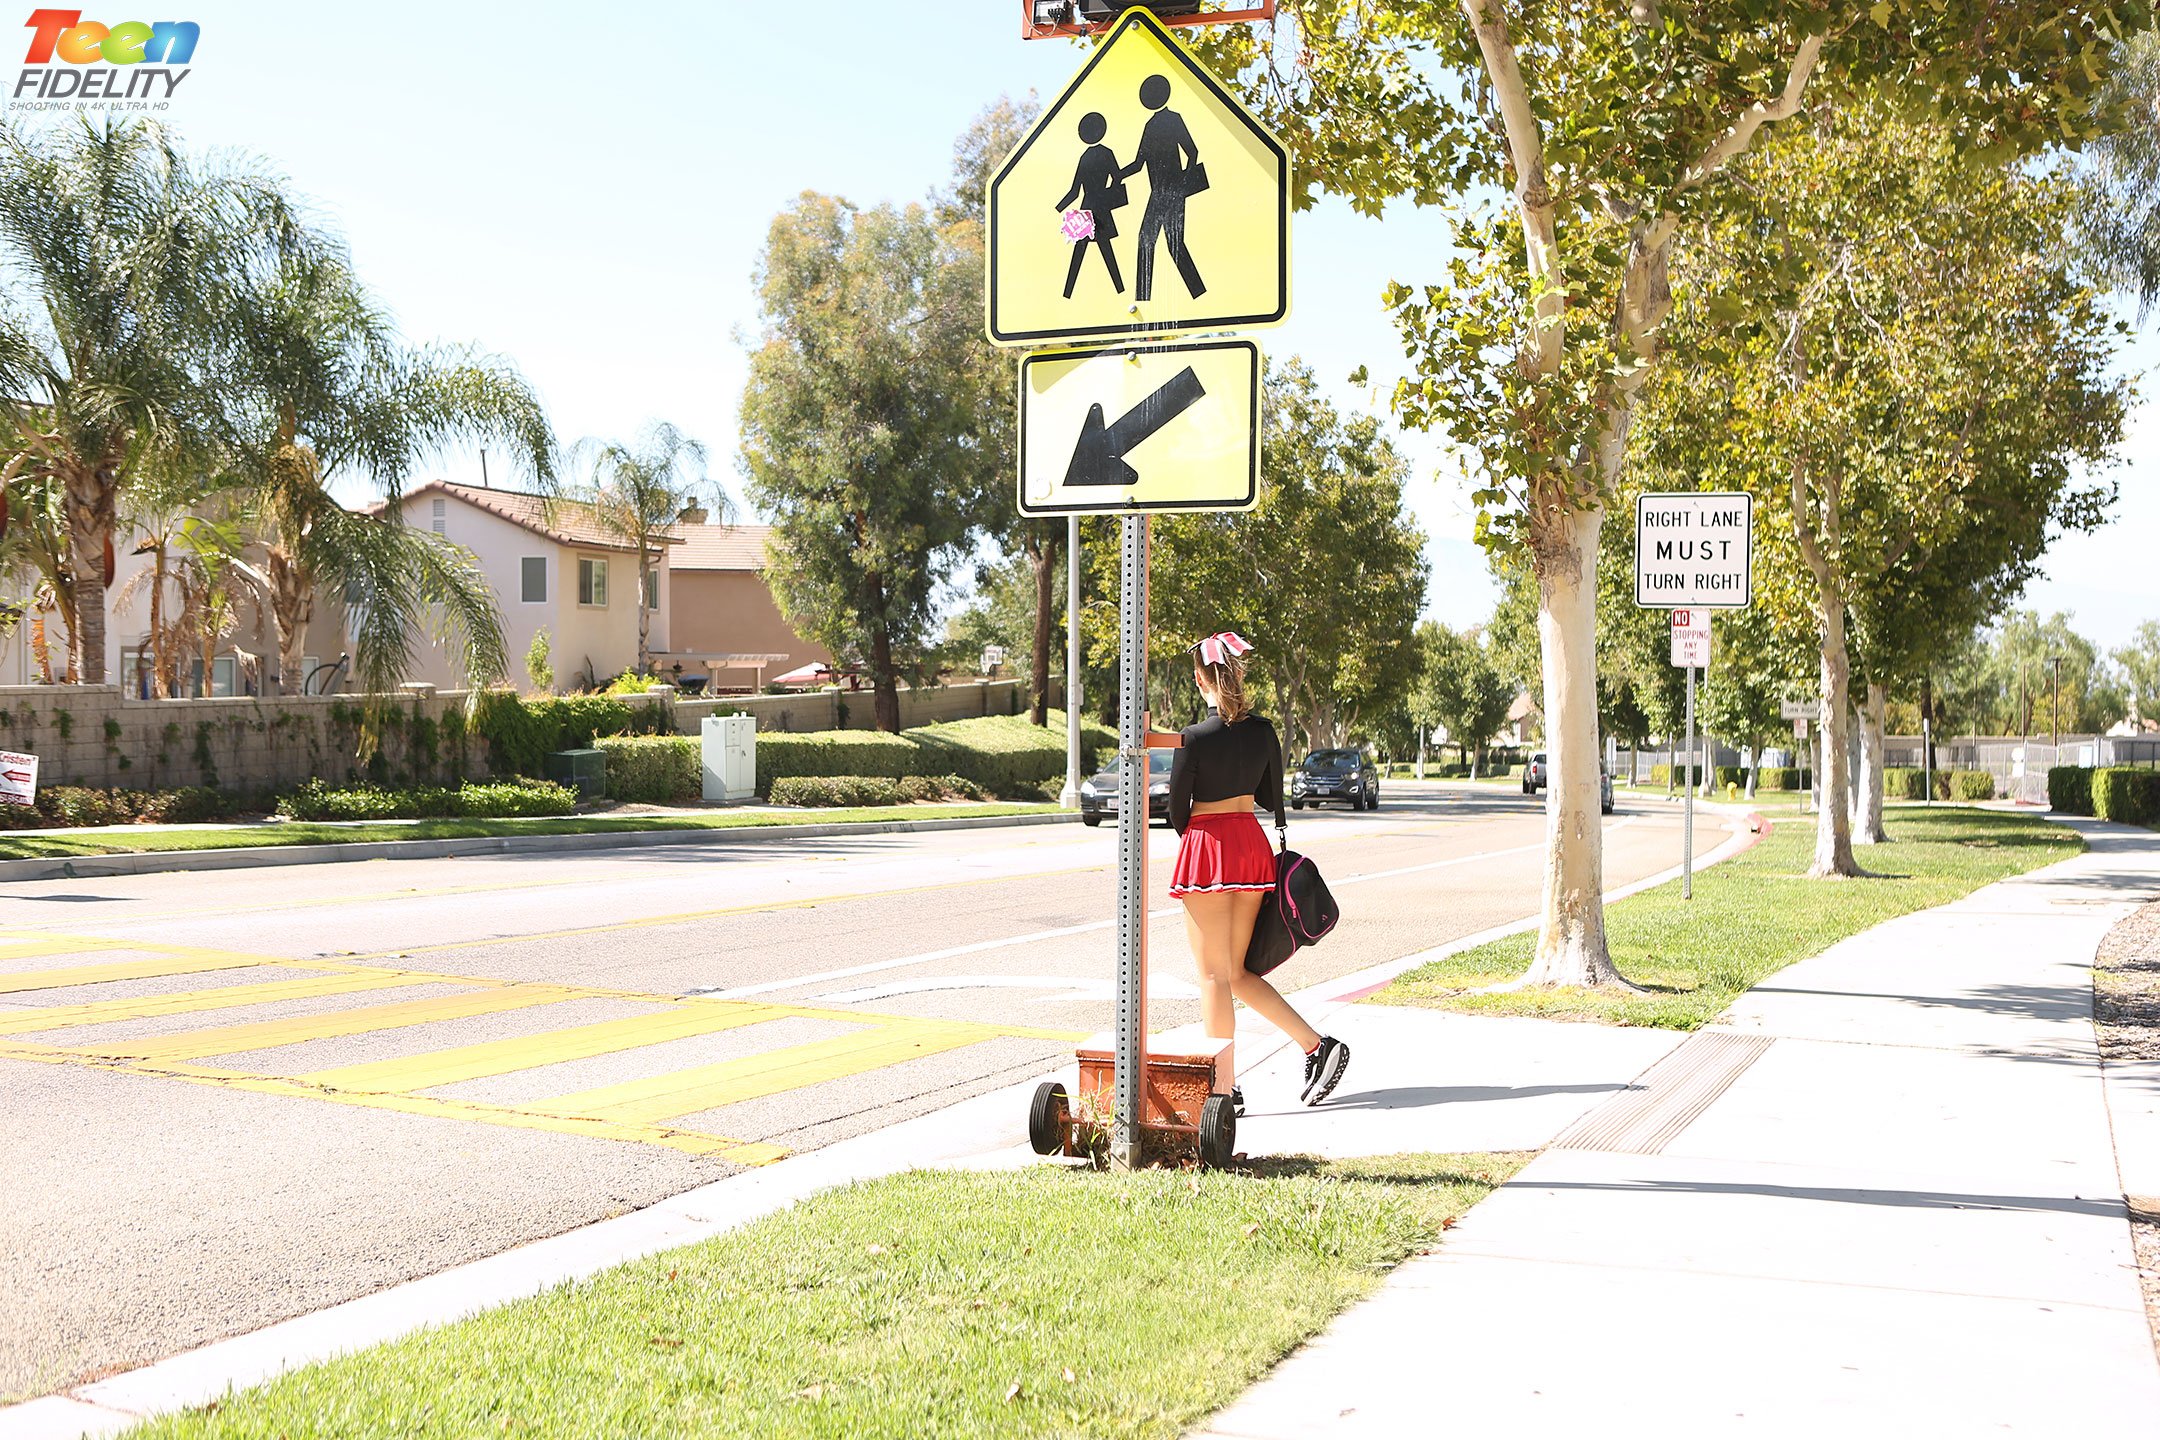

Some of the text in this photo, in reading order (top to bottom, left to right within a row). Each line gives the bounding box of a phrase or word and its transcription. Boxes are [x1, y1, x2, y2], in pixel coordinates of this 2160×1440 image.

[1645, 511, 1743, 527] RIGHT LANE
[1656, 541, 1731, 560] MUST
[1644, 574, 1742, 589] TURN RIGHT
[1674, 611, 1688, 625] NO
[1673, 630, 1709, 640] STOPPING
[1684, 641, 1697, 649] ANY
[1684, 651, 1697, 660] TIME
